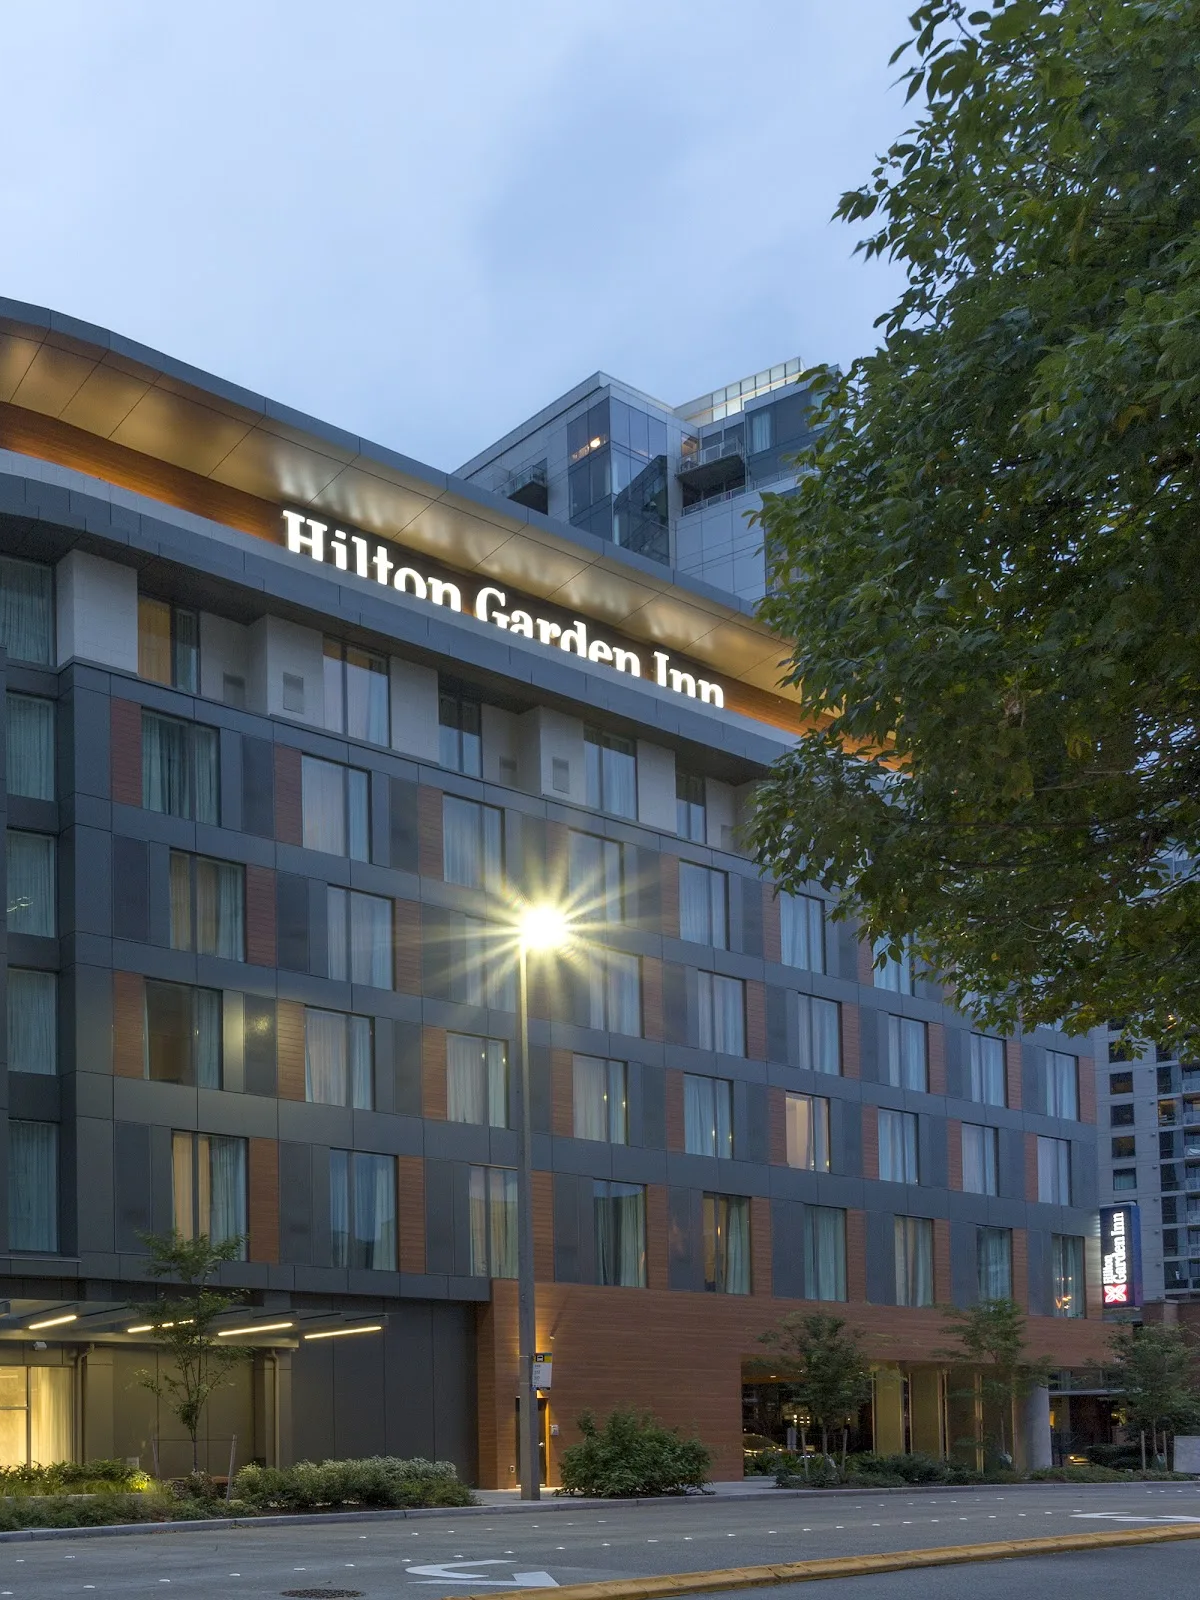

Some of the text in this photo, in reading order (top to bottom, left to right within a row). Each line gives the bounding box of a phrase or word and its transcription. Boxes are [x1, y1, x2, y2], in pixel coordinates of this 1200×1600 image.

[282, 509, 725, 709] Hilton Garden Inn
[1102, 1254, 1113, 1285] Hilton
[1111, 1211, 1127, 1284] Garden Inn
